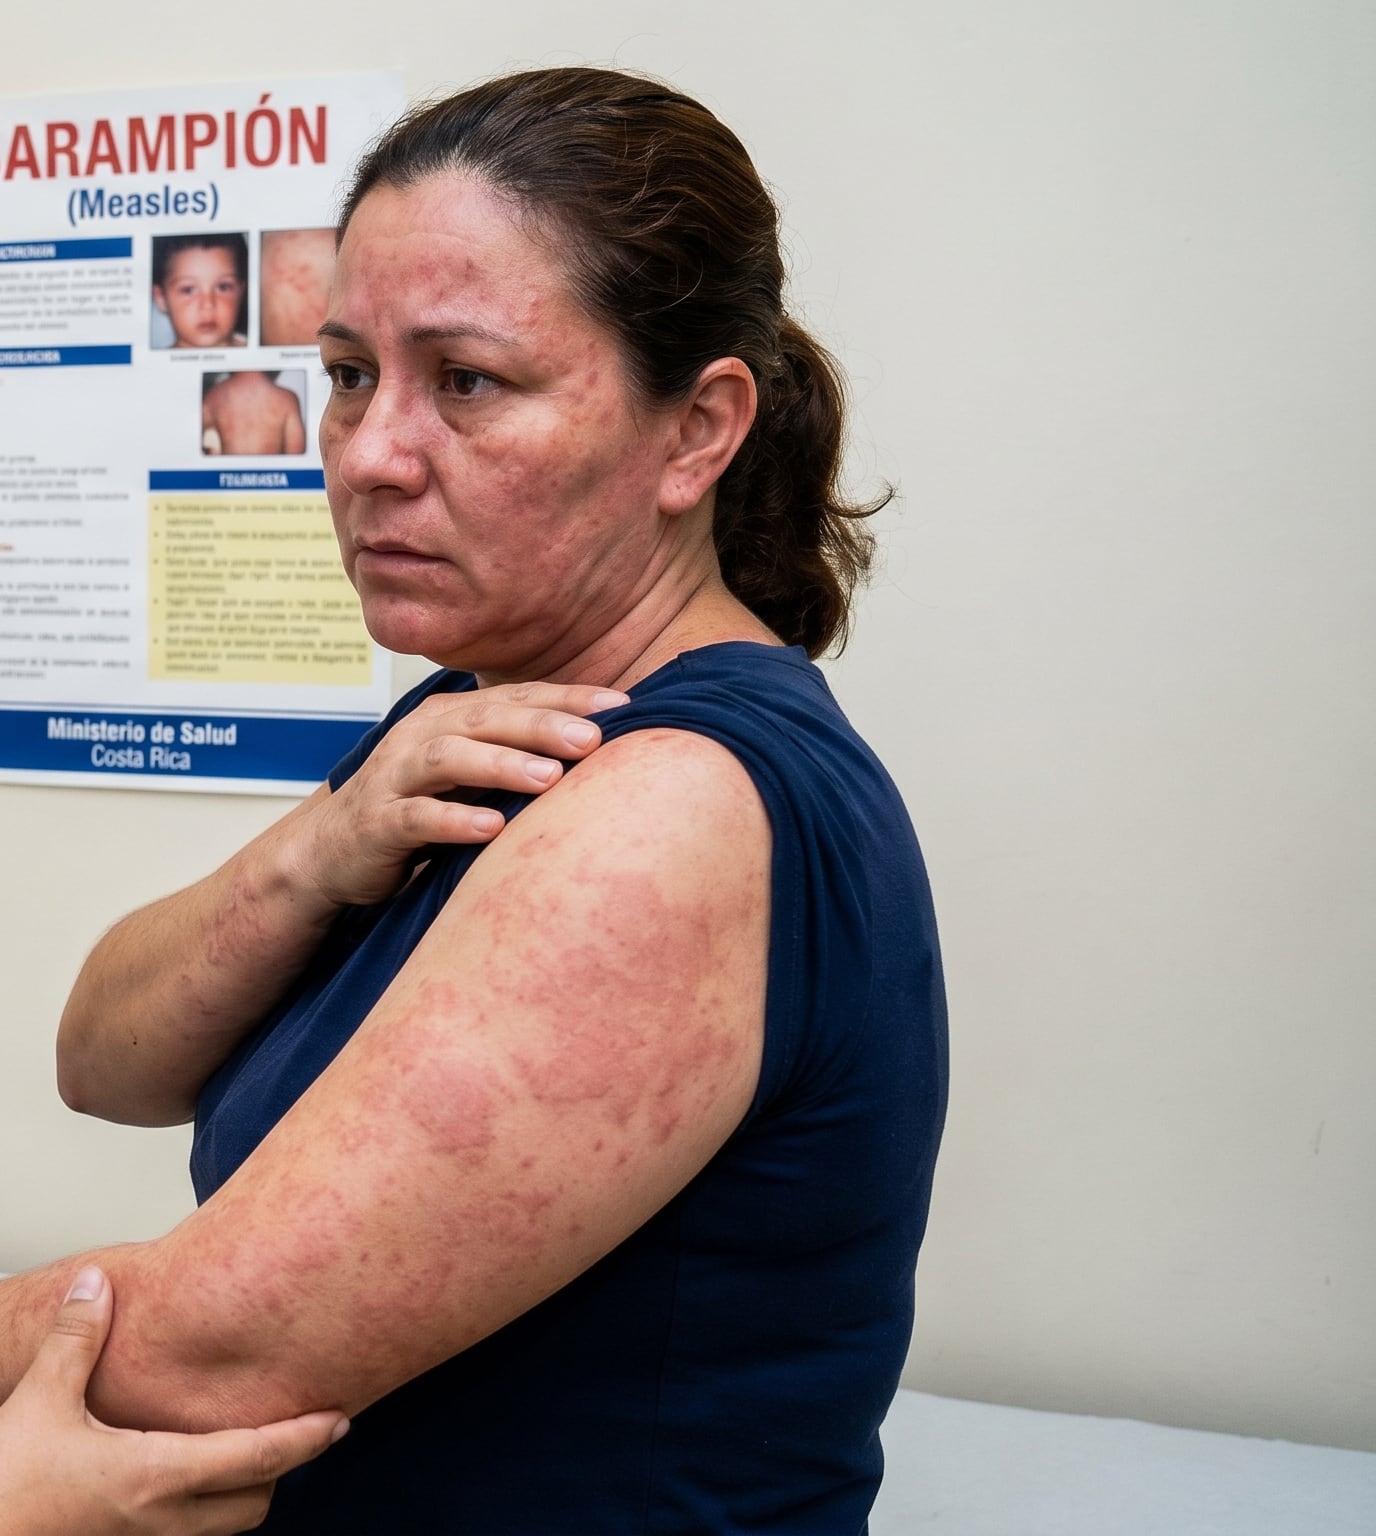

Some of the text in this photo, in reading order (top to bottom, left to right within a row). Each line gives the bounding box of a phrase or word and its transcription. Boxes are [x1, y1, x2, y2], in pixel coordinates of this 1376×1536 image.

[68, 183, 220, 226] (Measles)
[47, 717, 237, 746] Ministerio de Salud
[91, 744, 191, 770] Costa Rica
